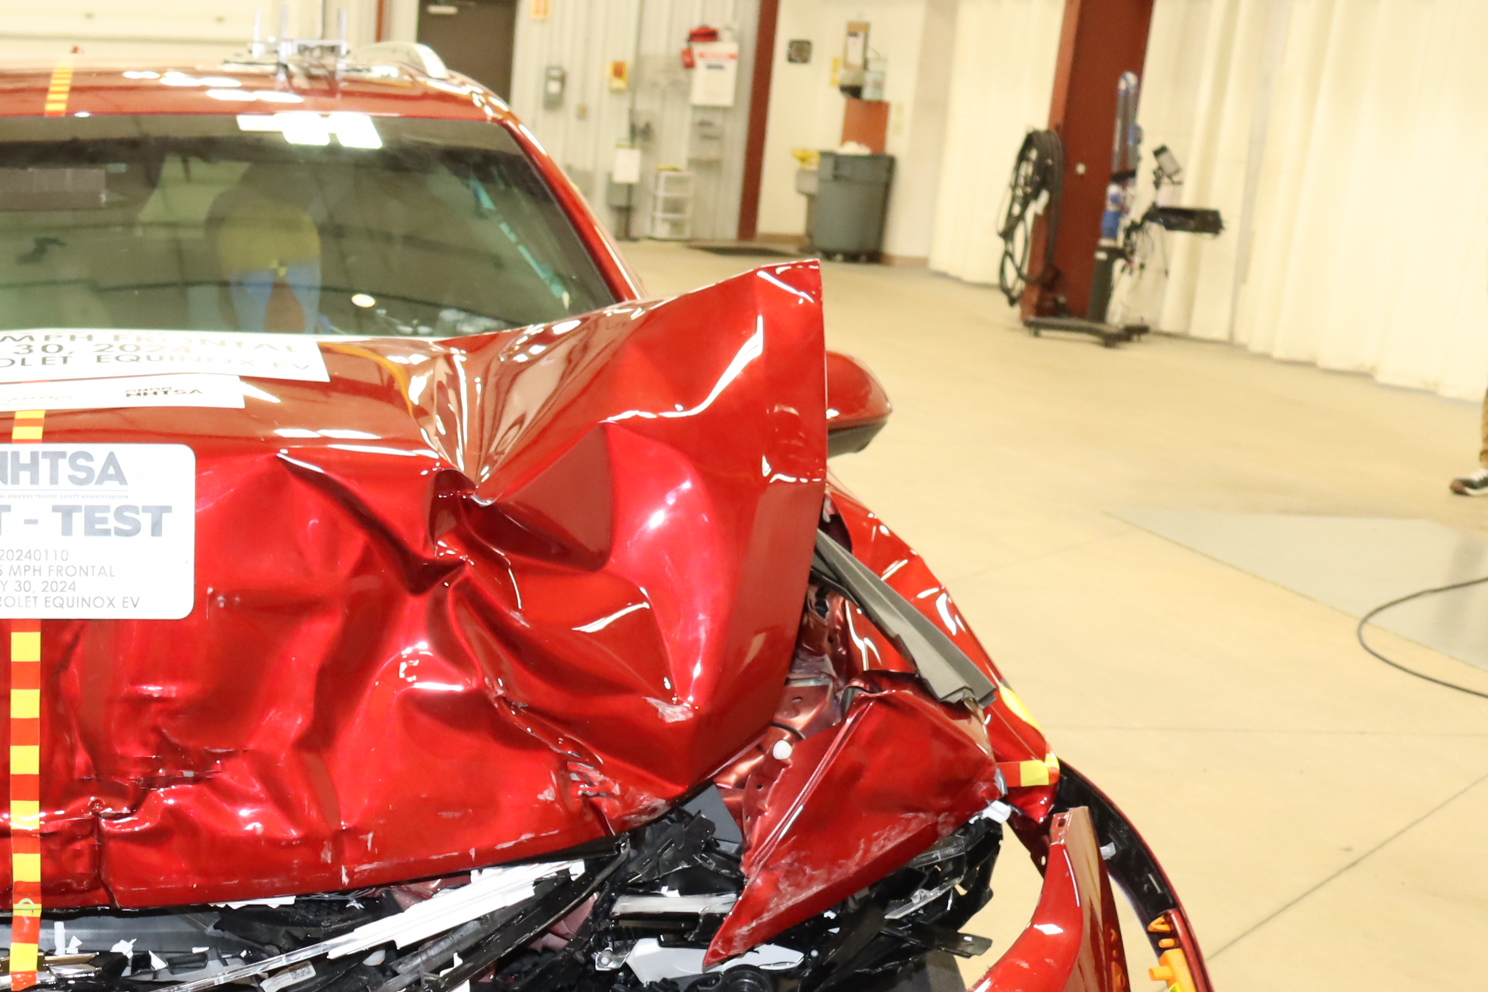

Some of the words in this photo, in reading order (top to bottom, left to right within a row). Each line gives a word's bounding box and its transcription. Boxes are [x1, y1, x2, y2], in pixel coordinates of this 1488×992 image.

[0, 334, 94, 344] MPH
[113, 334, 303, 353] FRONTAL
[13, 343, 73, 356] 30,
[93, 343, 192, 354] 2024
[96, 353, 256, 367] EQUINOX
[272, 361, 312, 371] EV
[51, 505, 172, 537] TEST
[8, 564, 42, 577] MPH
[48, 565, 115, 578] FRONTAL
[14, 580, 36, 595] 30,
[41, 580, 76, 593] 2024
[44, 596, 116, 610] EQUINOX
[122, 596, 140, 609] EV
